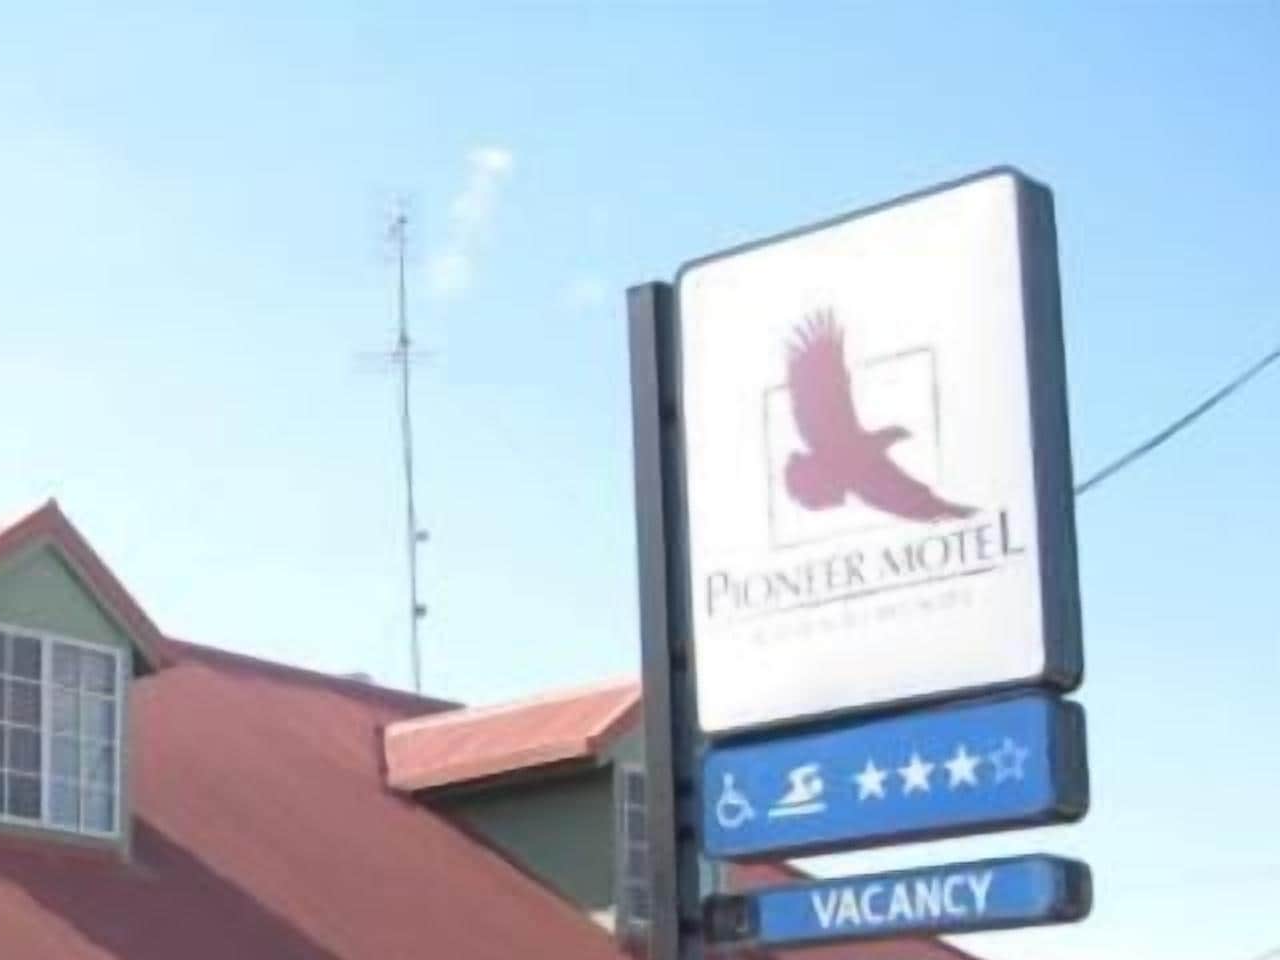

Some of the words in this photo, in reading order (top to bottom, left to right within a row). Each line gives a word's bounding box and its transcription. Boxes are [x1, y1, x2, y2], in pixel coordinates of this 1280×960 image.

[704, 550, 866, 618] PIONEER
[880, 509, 1026, 582] MOTEL
[811, 870, 994, 929] VACANCY
